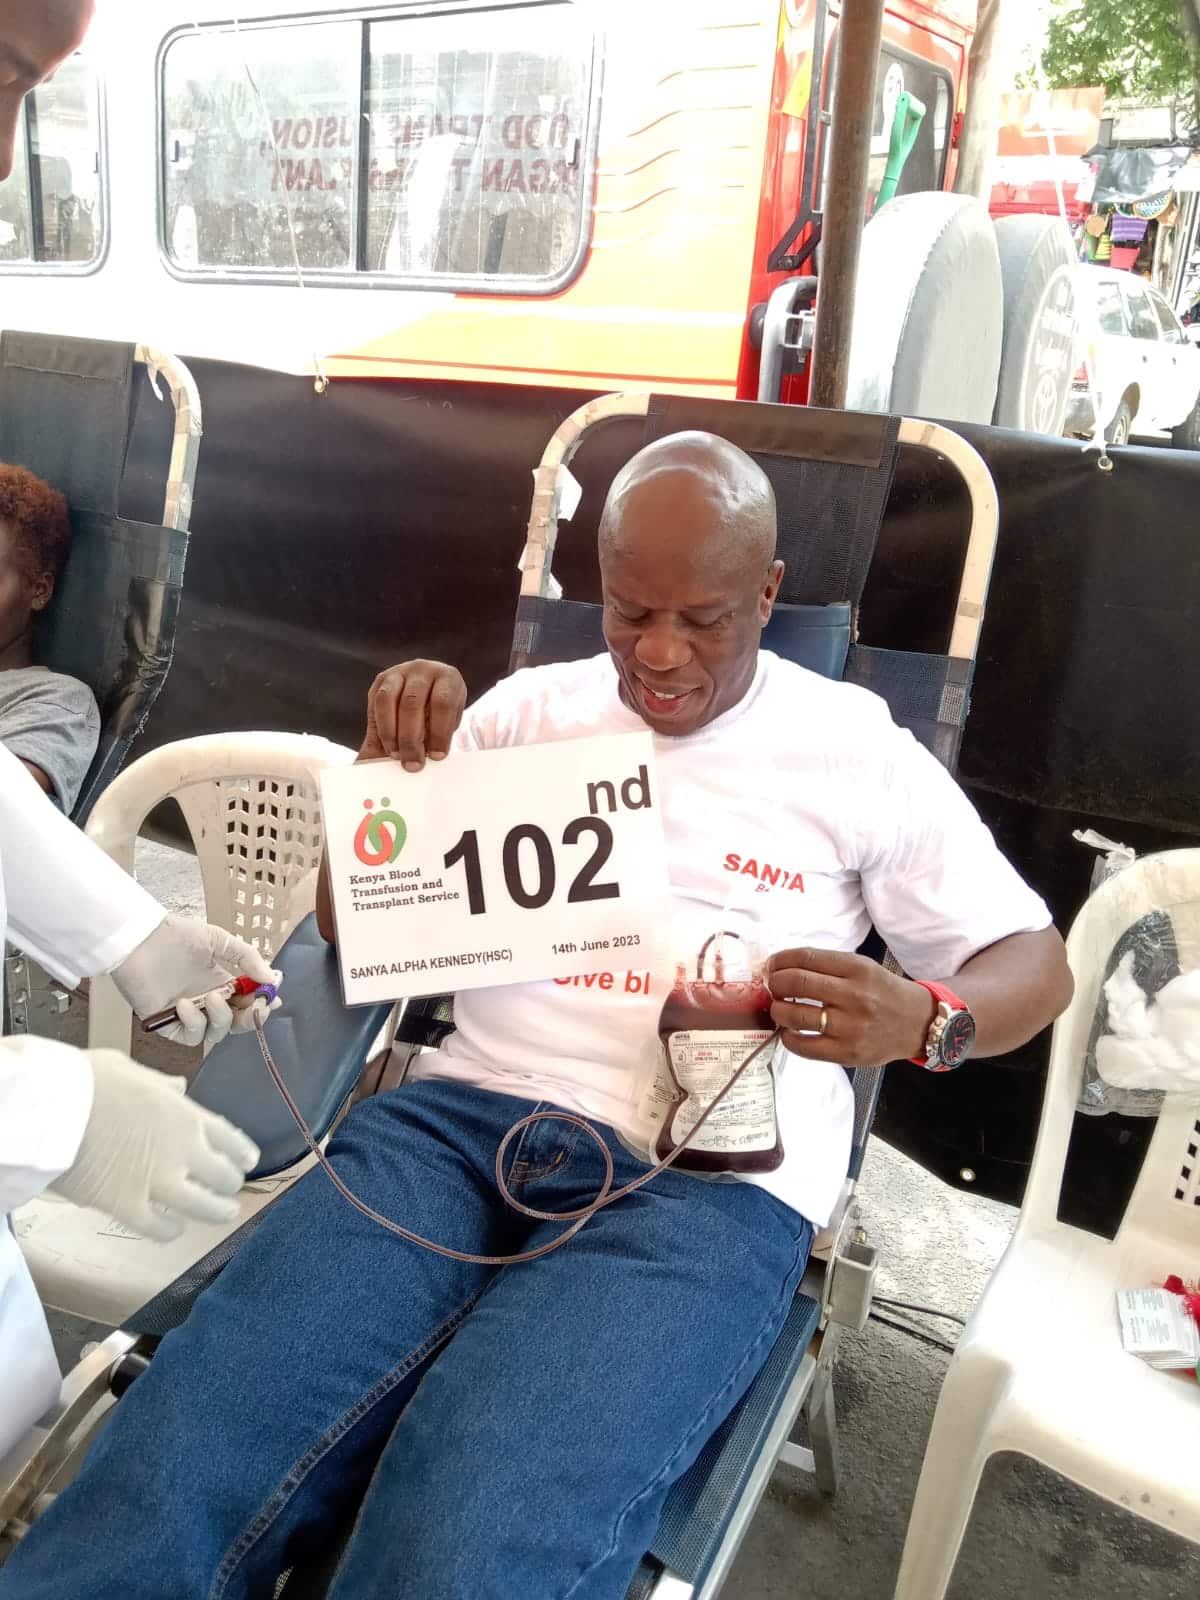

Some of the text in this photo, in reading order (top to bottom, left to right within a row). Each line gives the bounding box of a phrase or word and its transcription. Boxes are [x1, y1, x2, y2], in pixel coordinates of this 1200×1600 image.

[586, 764, 652, 815] nd
[443, 815, 621, 915] 102
[349, 867, 421, 885] Kenya Blood
[351, 878, 443, 898] Transfusion and
[352, 891, 460, 911] Transplant Service
[551, 934, 641, 954] 14th June 2023
[350, 948, 513, 979] SANYA ALPHA KENNEDY(HSC)
